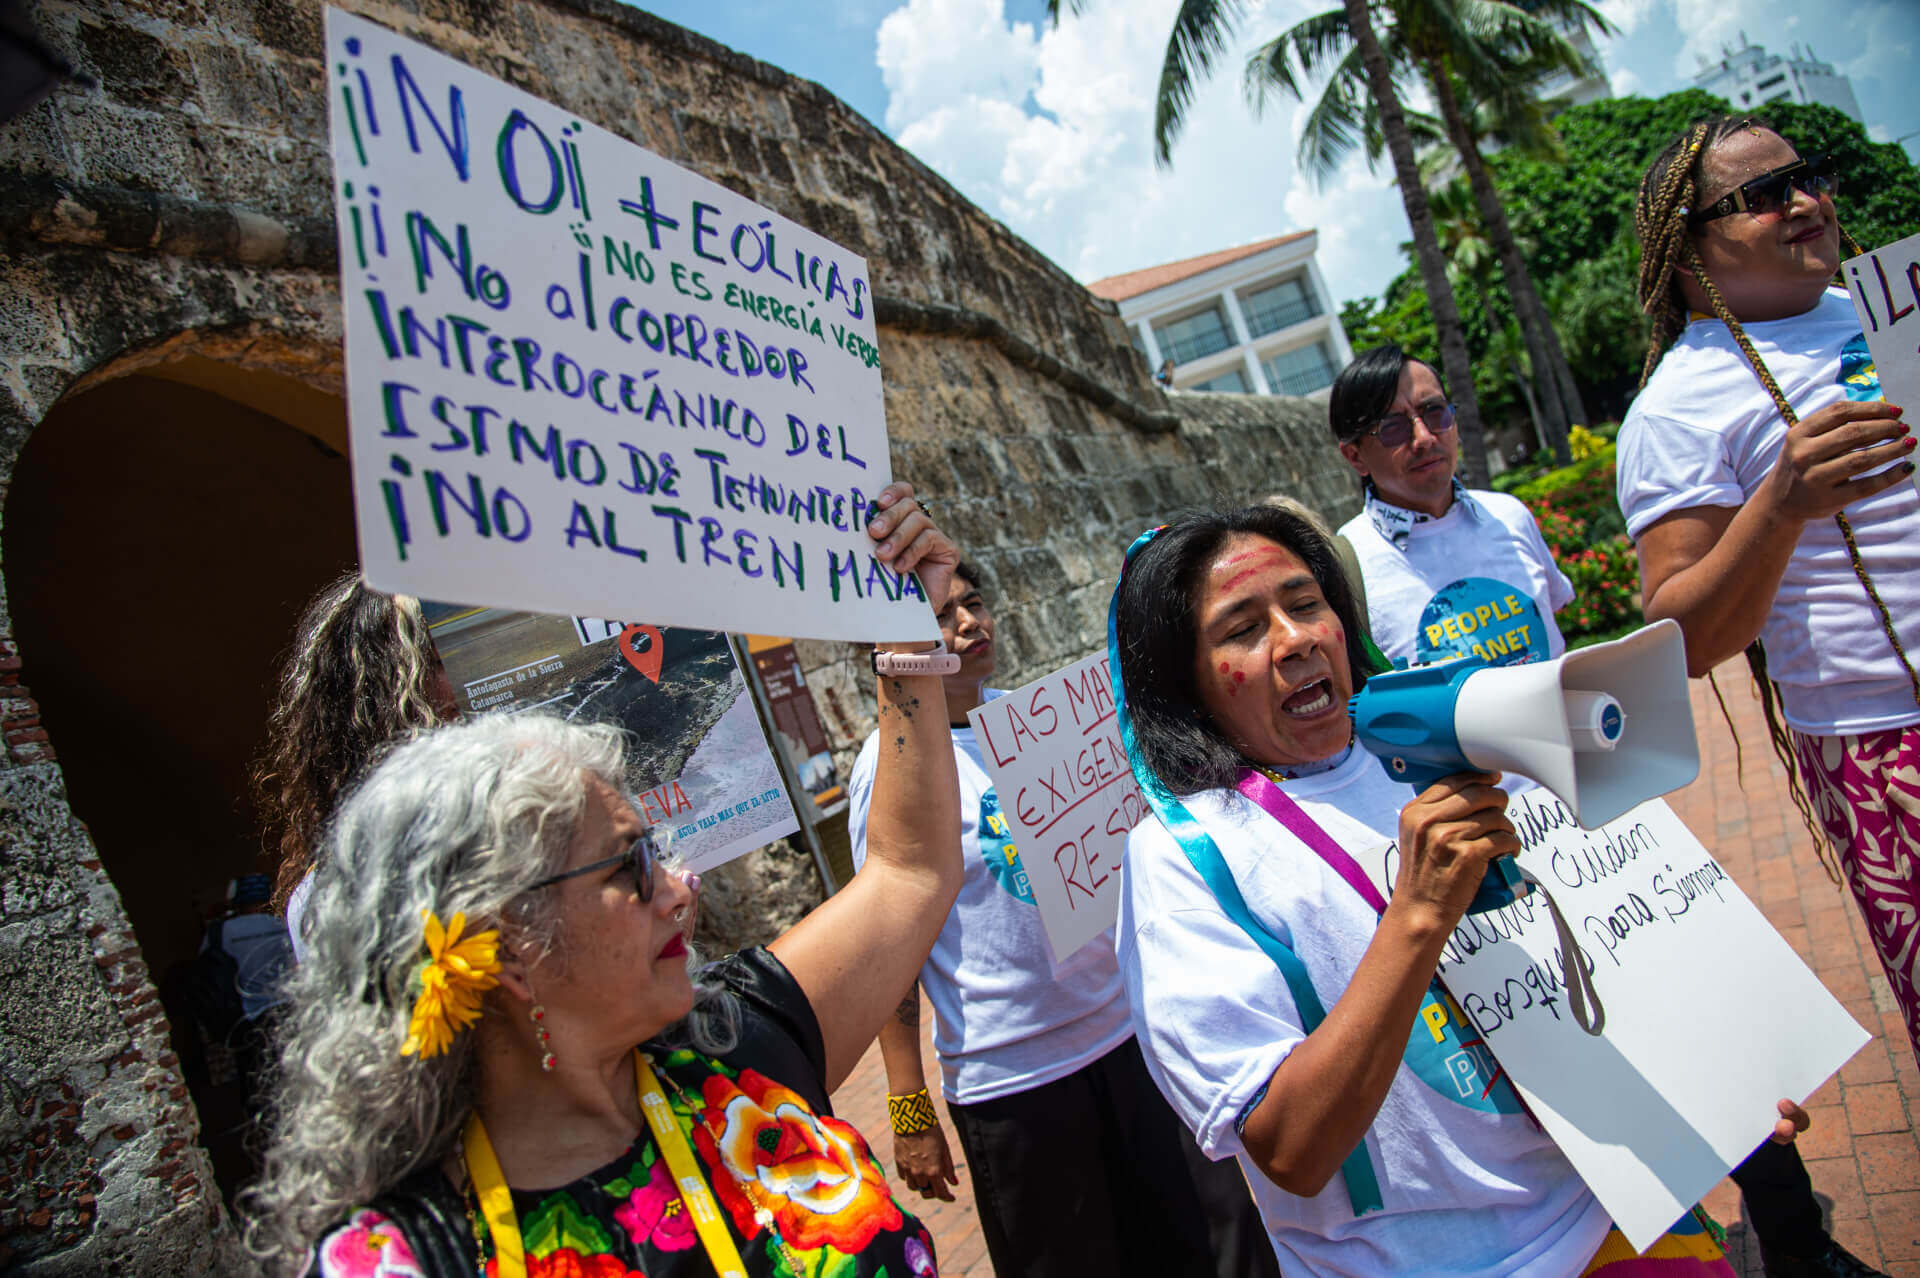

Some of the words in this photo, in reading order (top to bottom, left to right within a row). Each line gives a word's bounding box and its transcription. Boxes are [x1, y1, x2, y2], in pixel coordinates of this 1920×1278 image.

[670, 261, 713, 301] ES
[608, 296, 816, 395] CORREDOR
[380, 381, 607, 487] ISTMO
[618, 441, 681, 498] DE
[785, 413, 867, 470] DEL
[564, 499, 648, 563] AL
[651, 504, 805, 592] TREN
[826, 548, 927, 603] MAYA
[1424, 594, 1524, 649] PEOPLE
[978, 686, 1059, 768] LAS
[1584, 892, 1660, 967] para
